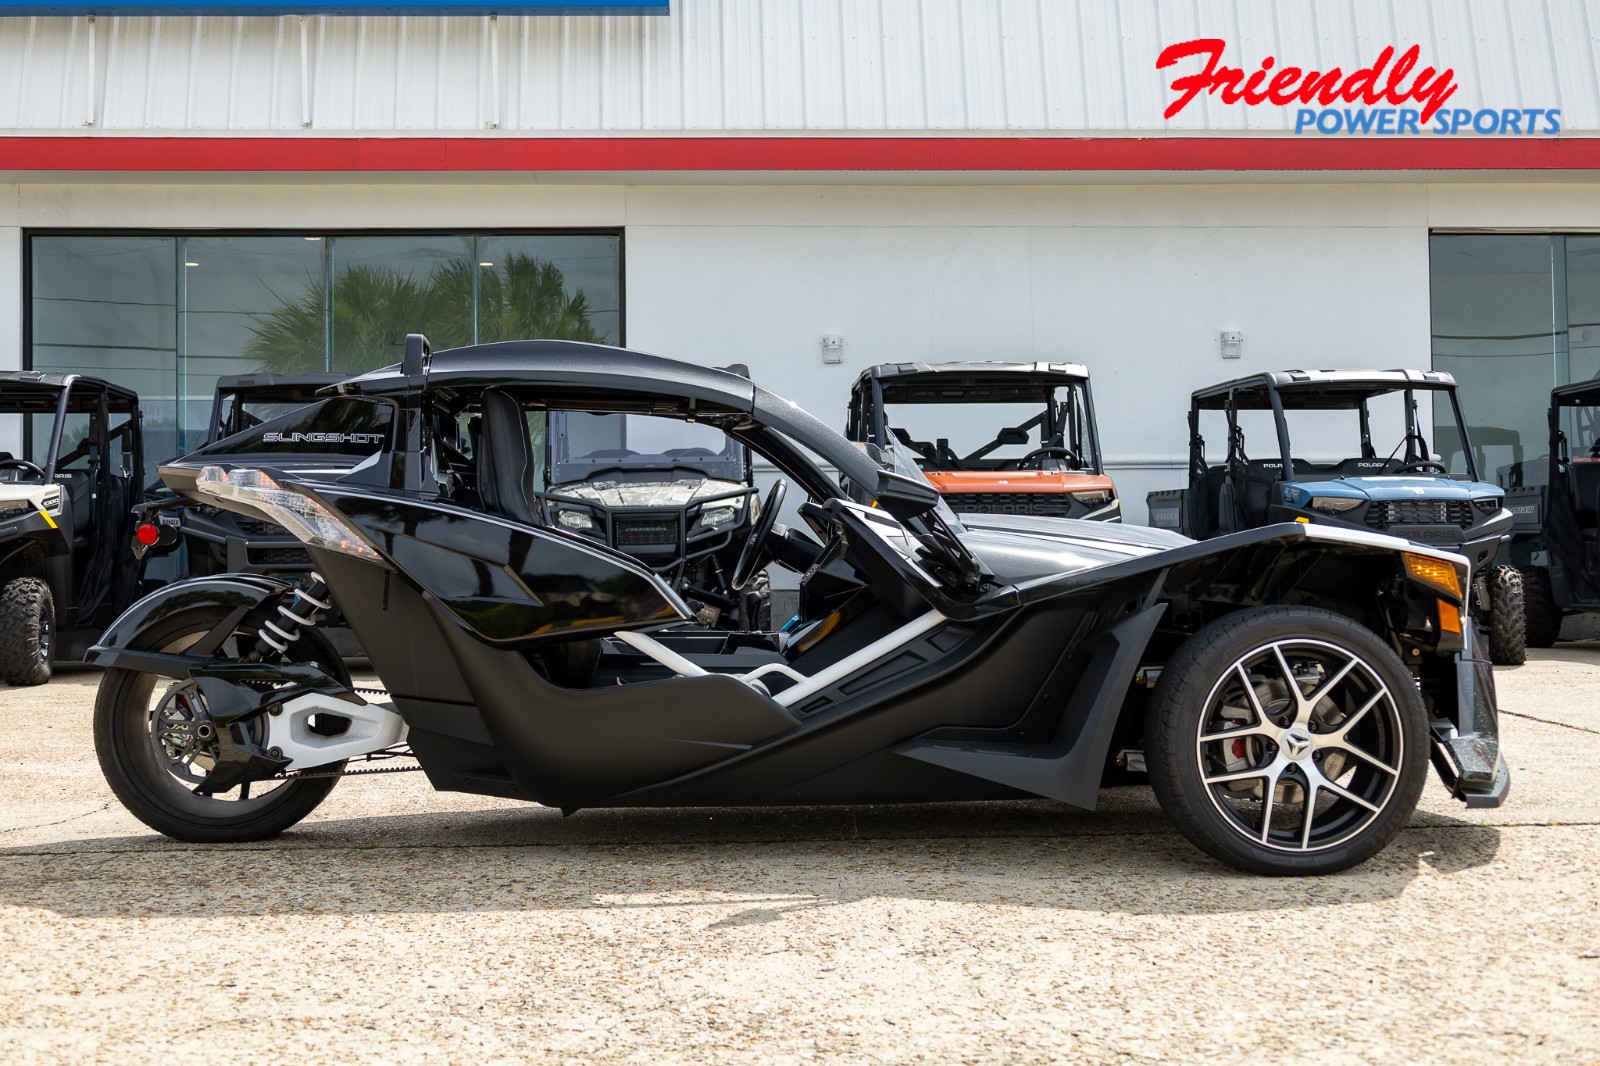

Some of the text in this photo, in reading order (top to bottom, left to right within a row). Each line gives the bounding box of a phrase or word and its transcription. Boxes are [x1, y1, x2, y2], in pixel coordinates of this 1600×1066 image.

[263, 432, 385, 444] SLINGSHOT
[963, 503, 1047, 515] POLARIS
[1396, 530, 1456, 539] POLARIS
